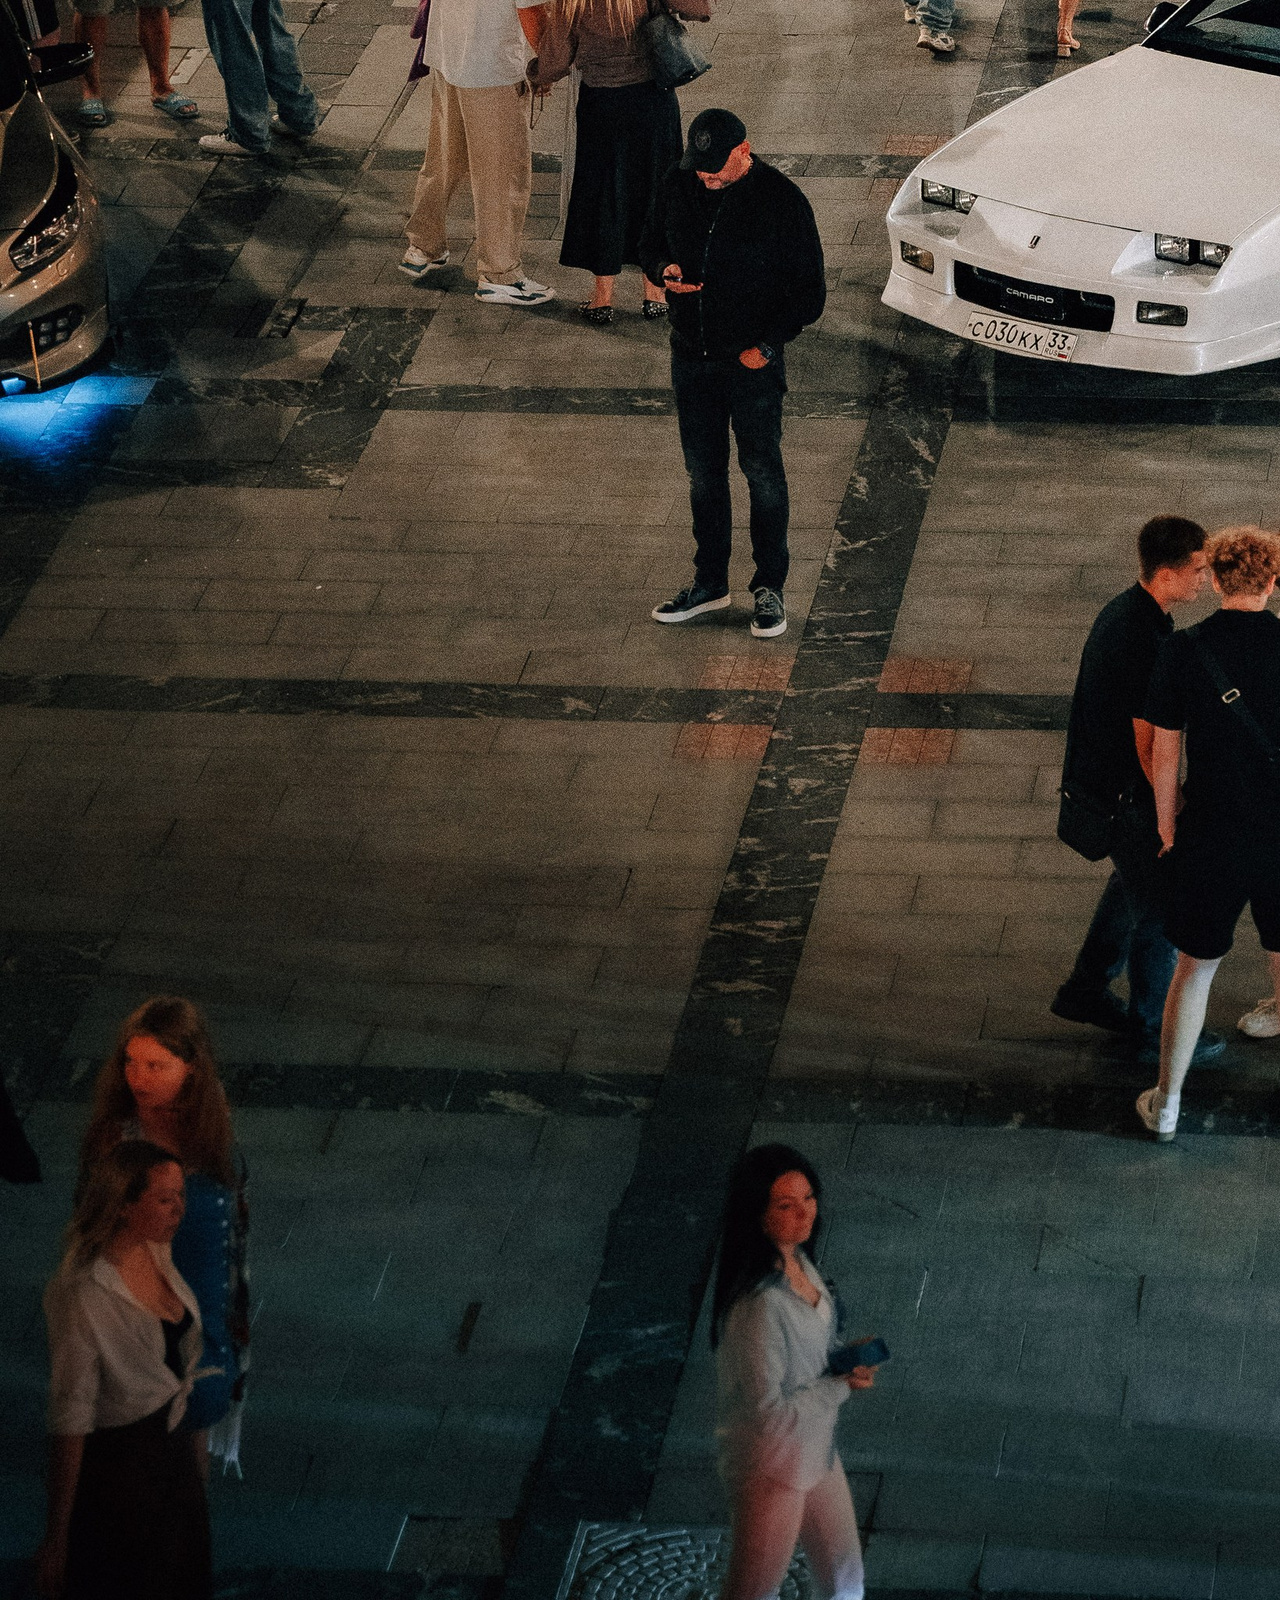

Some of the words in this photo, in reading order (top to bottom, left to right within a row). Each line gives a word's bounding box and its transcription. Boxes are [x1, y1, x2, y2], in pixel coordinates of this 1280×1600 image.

[1006, 287, 1054, 304] CAMARO
[1048, 332, 1069, 350] 33
[1044, 347, 1058, 357] RUS
